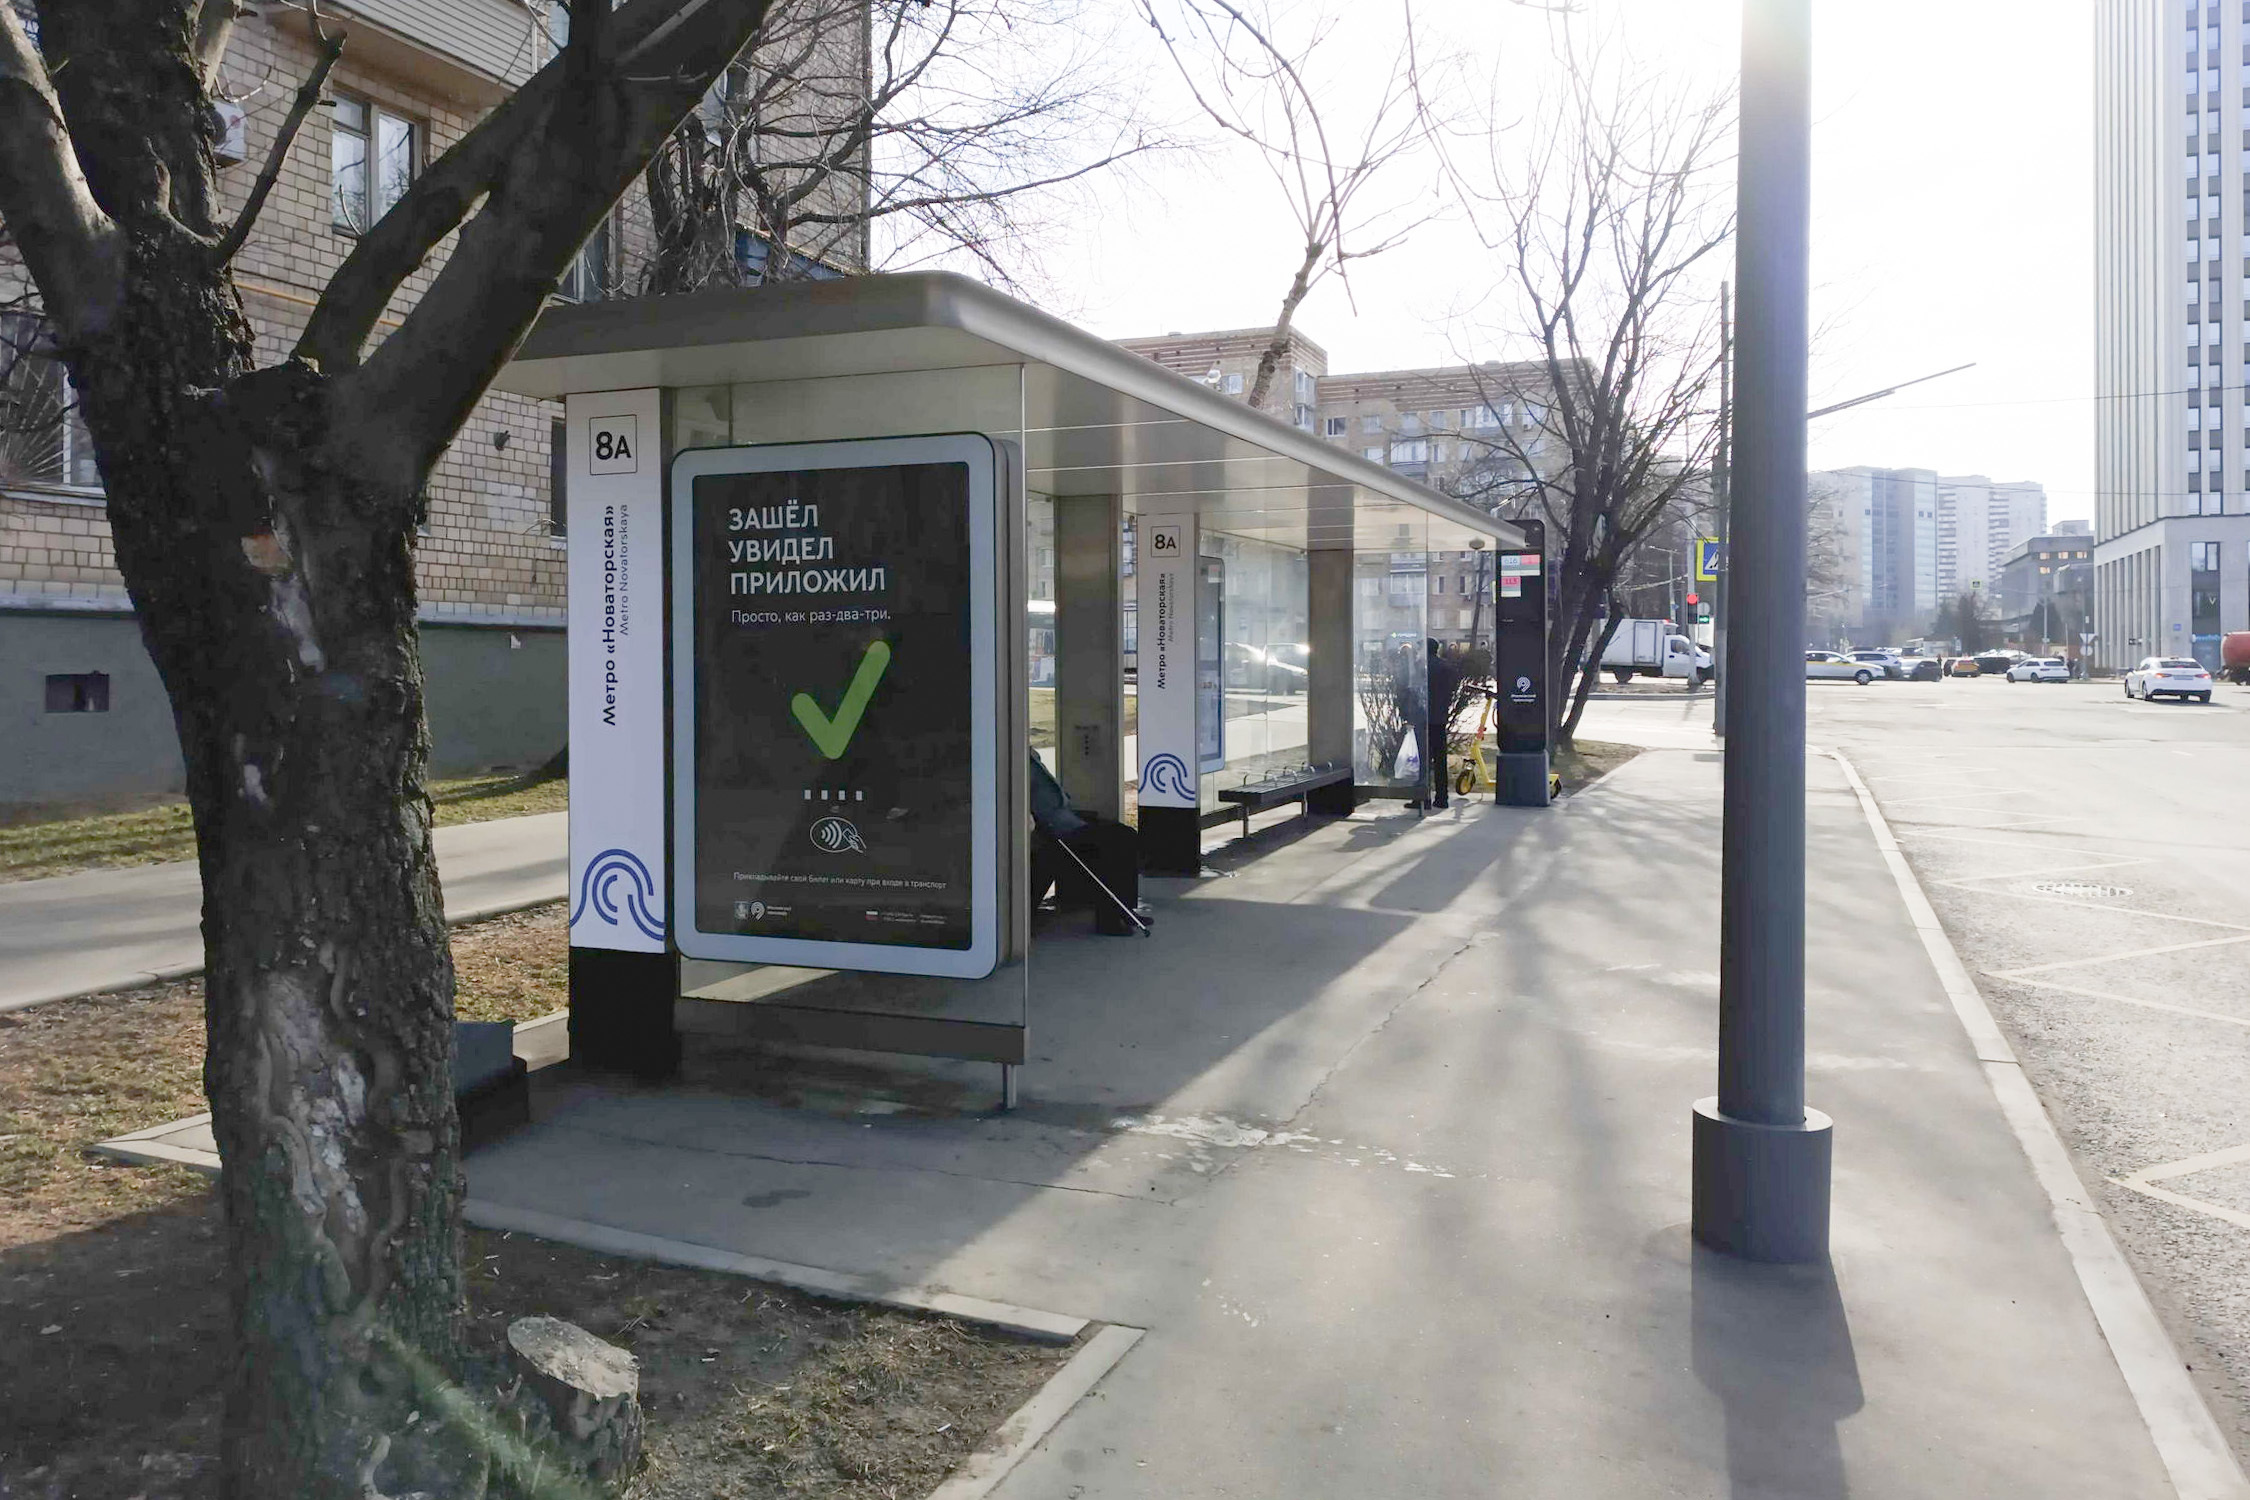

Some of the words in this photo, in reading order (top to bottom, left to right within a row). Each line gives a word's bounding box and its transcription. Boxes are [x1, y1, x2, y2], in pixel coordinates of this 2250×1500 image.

[728, 499, 819, 531] ЗАШЁЛ
[619, 504, 629, 591] Novatorskaya
[727, 536, 834, 566] УВИДЕЛ
[602, 505, 618, 655] «Новаторская»
[730, 567, 886, 595] ПРИЛОЖИЛ
[619, 595, 629, 636] Metro
[731, 610, 782, 624] Просто,
[785, 611, 806, 623] как
[810, 609, 891, 624] раз-два-три.
[1157, 654, 1167, 690] Метро
[603, 659, 618, 726] Метро
